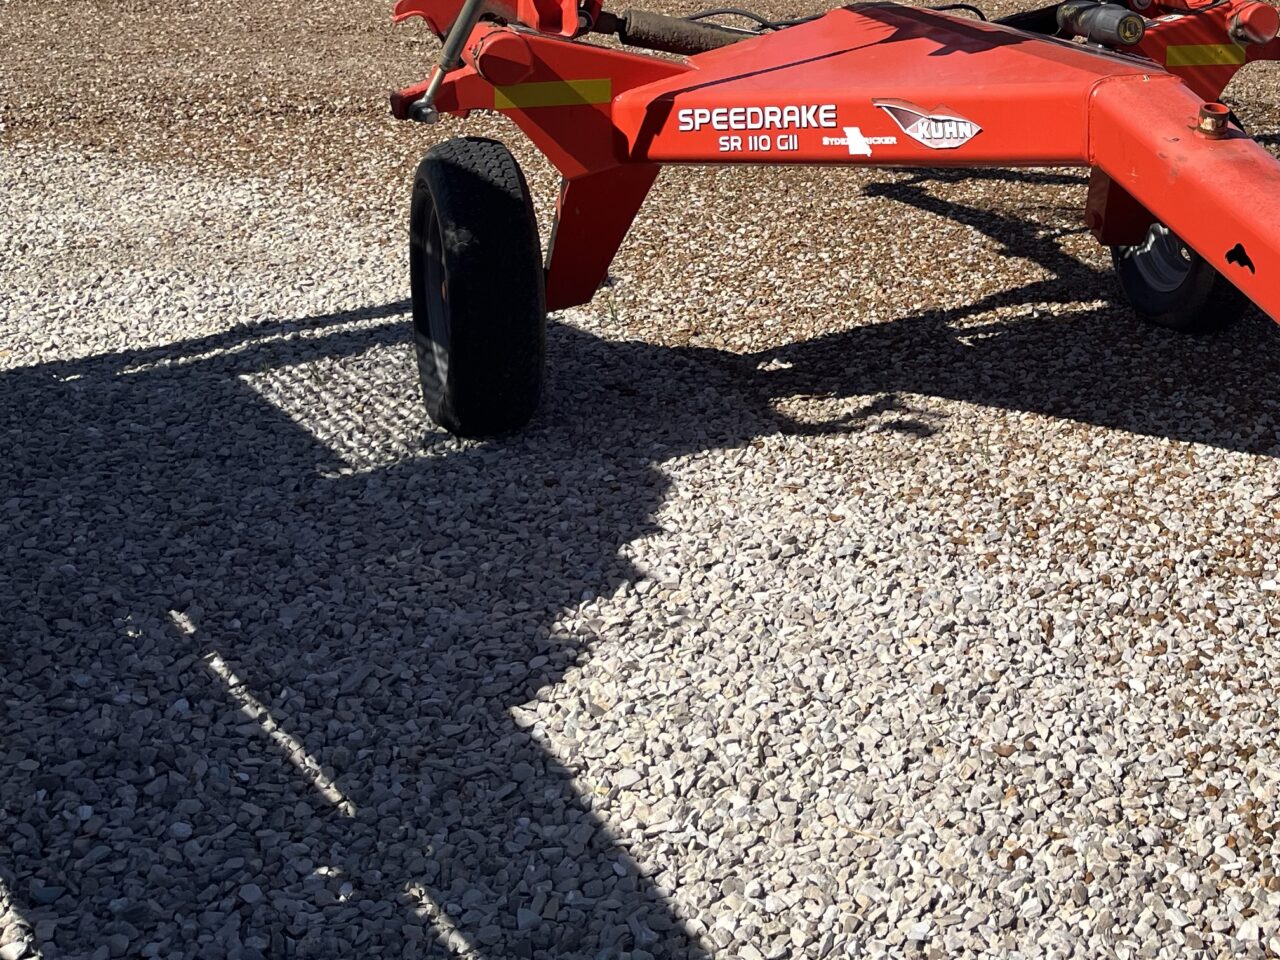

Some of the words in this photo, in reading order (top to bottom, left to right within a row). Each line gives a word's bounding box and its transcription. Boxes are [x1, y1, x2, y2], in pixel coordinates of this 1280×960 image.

[678, 104, 838, 132] SPEEDRAKE
[918, 121, 972, 140] KUHN
[718, 135, 743, 152] SR
[776, 134, 799, 151] GII
